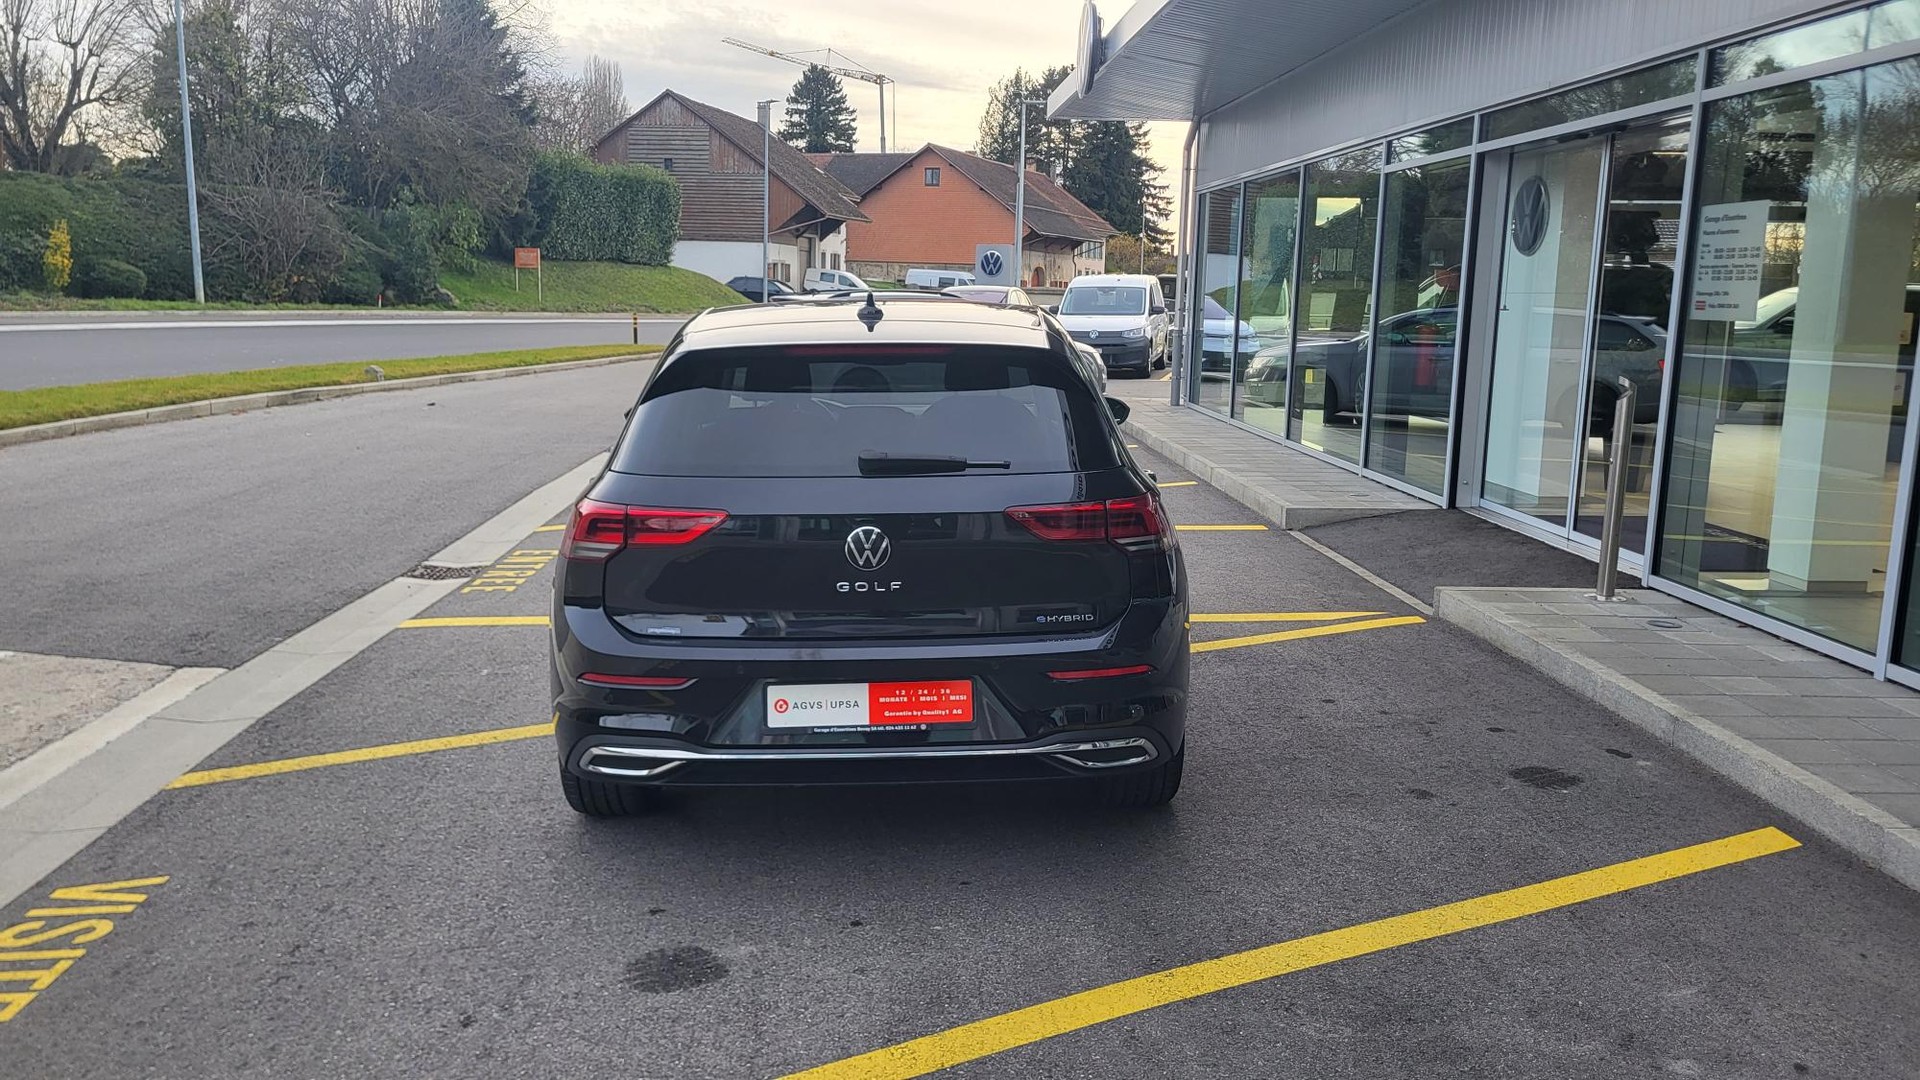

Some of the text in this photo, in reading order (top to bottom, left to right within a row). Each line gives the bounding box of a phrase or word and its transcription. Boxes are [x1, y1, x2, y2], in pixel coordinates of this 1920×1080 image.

[846, 527, 890, 570] VW
[836, 582, 902, 592] GOLF
[792, 700, 860, 710] AGVS UPSA
